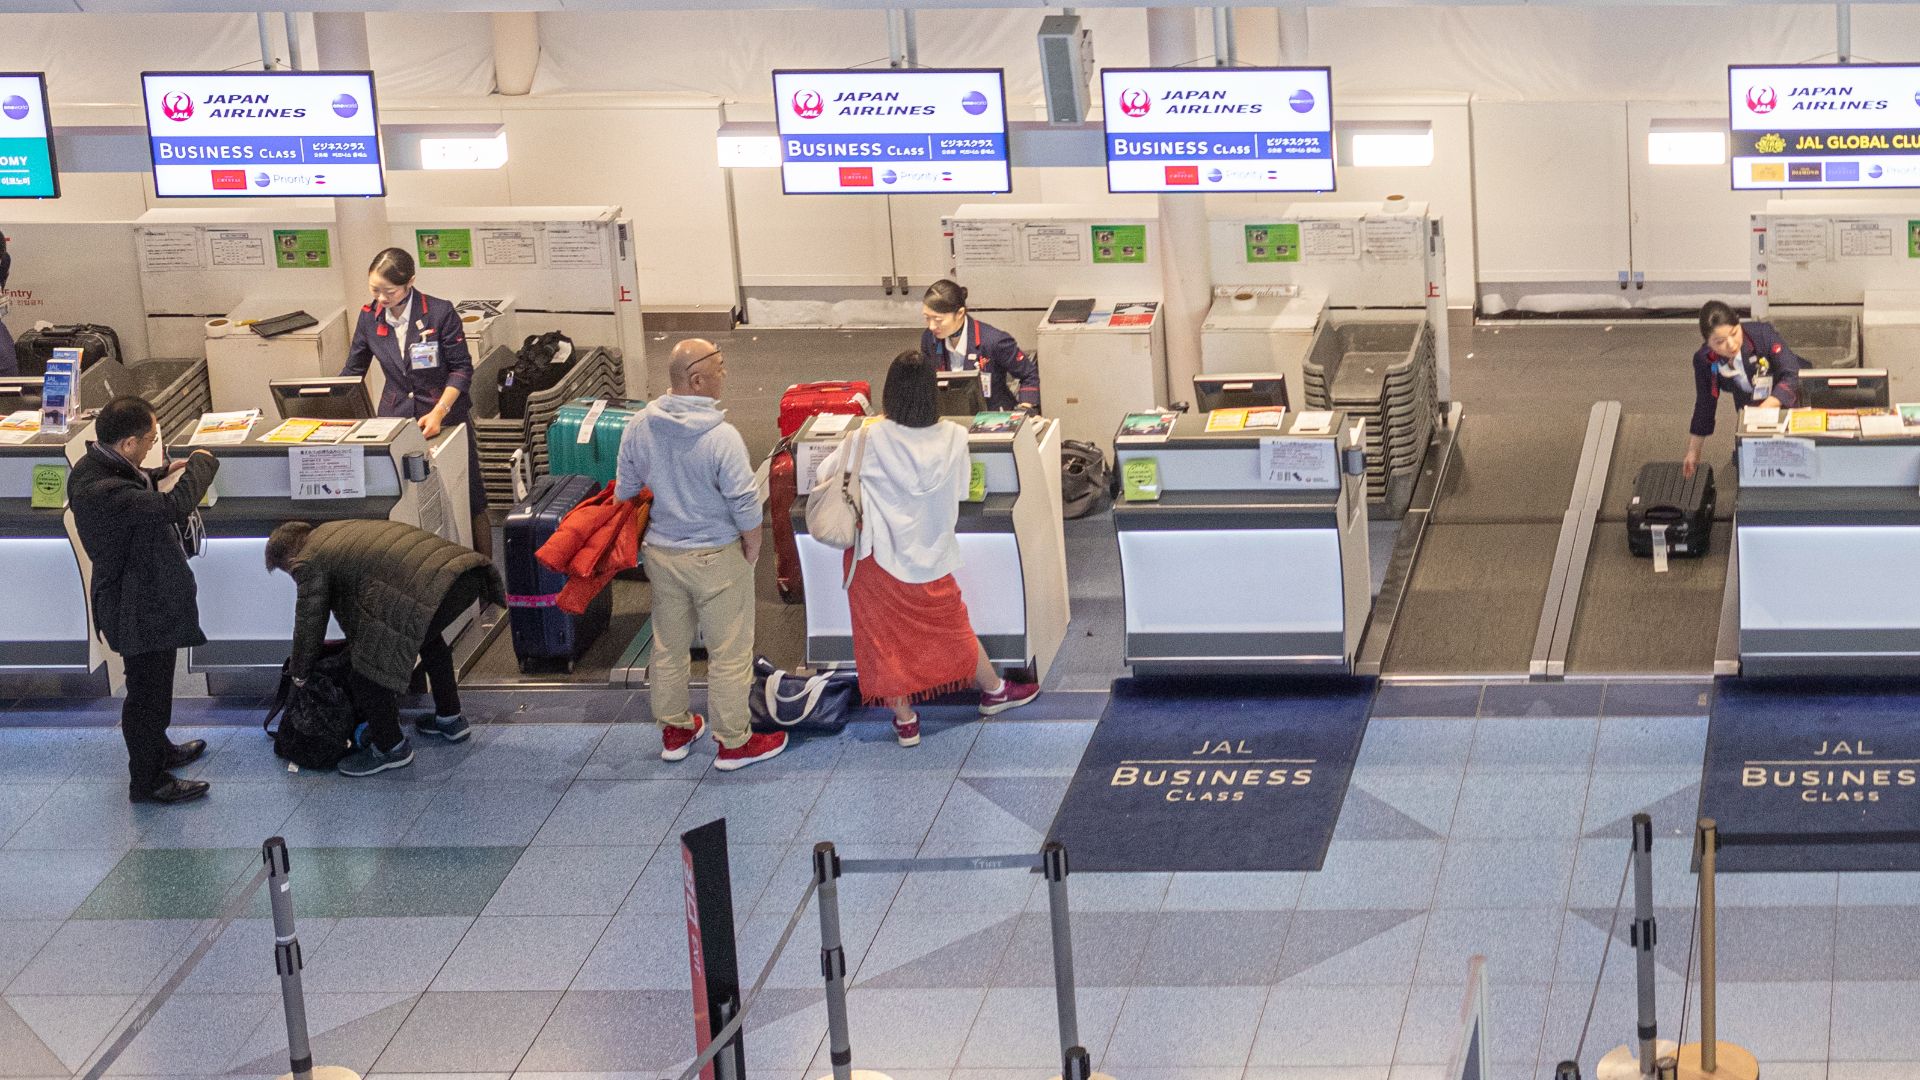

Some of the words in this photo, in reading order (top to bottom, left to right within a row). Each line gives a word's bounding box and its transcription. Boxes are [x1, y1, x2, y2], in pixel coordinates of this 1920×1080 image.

[833, 92, 900, 102] JAPAN
[1161, 90, 1227, 100] JAPAN
[1788, 87, 1853, 96] JAPAN
[203, 94, 270, 104] JAPAN
[838, 105, 936, 116] AIRLINES
[1165, 104, 1263, 114] AIRLINES
[1792, 100, 1888, 111] AIRLINES
[209, 108, 307, 118] AIRLINES
[800, 109, 819, 117] JAL
[312, 142, 366, 150] ビジネスクラス
[940, 139, 993, 148] ビジネスクラス
[1114, 139, 1208, 155] BUSINESS
[1213, 144, 1250, 154] CLASS
[1266, 138, 1320, 147] ビジネスクラス
[1796, 136, 1824, 149] JAL
[1827, 135, 1889, 149] GLOBAL
[160, 142, 254, 159] BUSINESS
[259, 148, 297, 159] CLASS
[787, 140, 882, 157] BUSINESS
[887, 146, 924, 156] CLASS
[273, 174, 311, 186] Priority
[1192, 740, 1253, 755] JAL
[1813, 740, 1874, 756] JAL
[1110, 767, 1313, 786] BUSINESS
[1165, 790, 1245, 802] CLASS
[1801, 790, 1880, 802] CLASS
